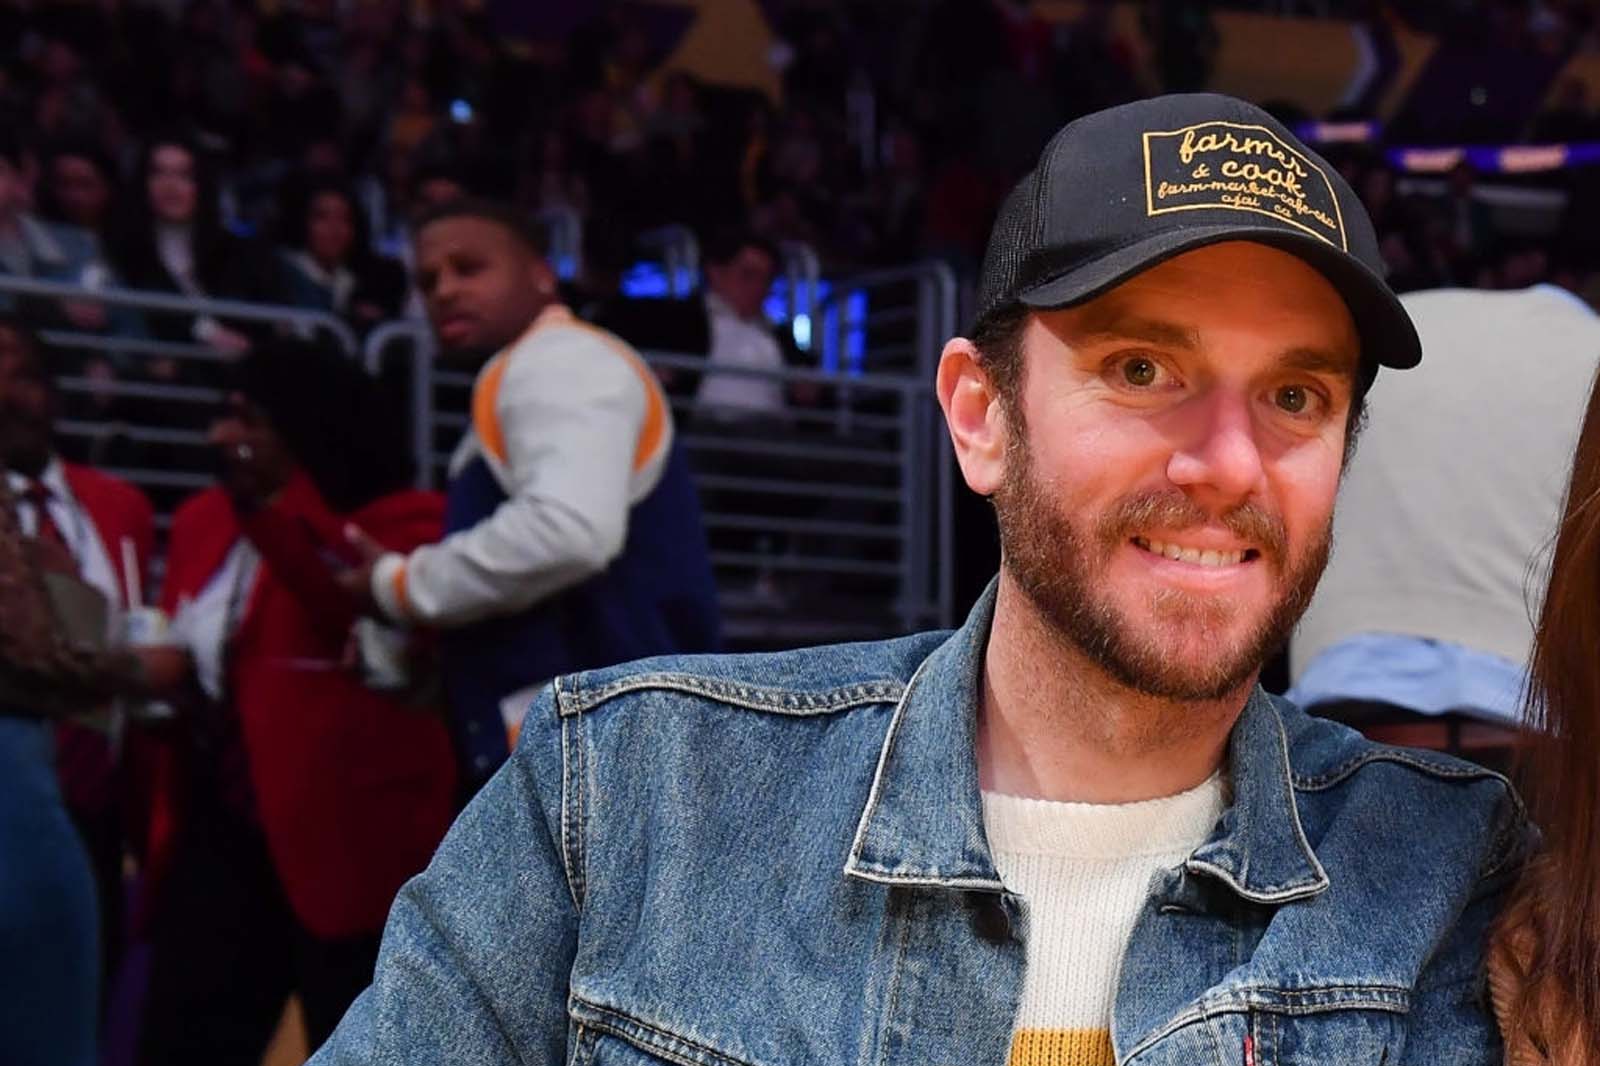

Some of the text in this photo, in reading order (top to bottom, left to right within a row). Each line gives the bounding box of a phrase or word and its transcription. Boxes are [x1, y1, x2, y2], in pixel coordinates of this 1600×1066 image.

[1179, 130, 1308, 178] farmer
[1192, 160, 1307, 198] & cook
